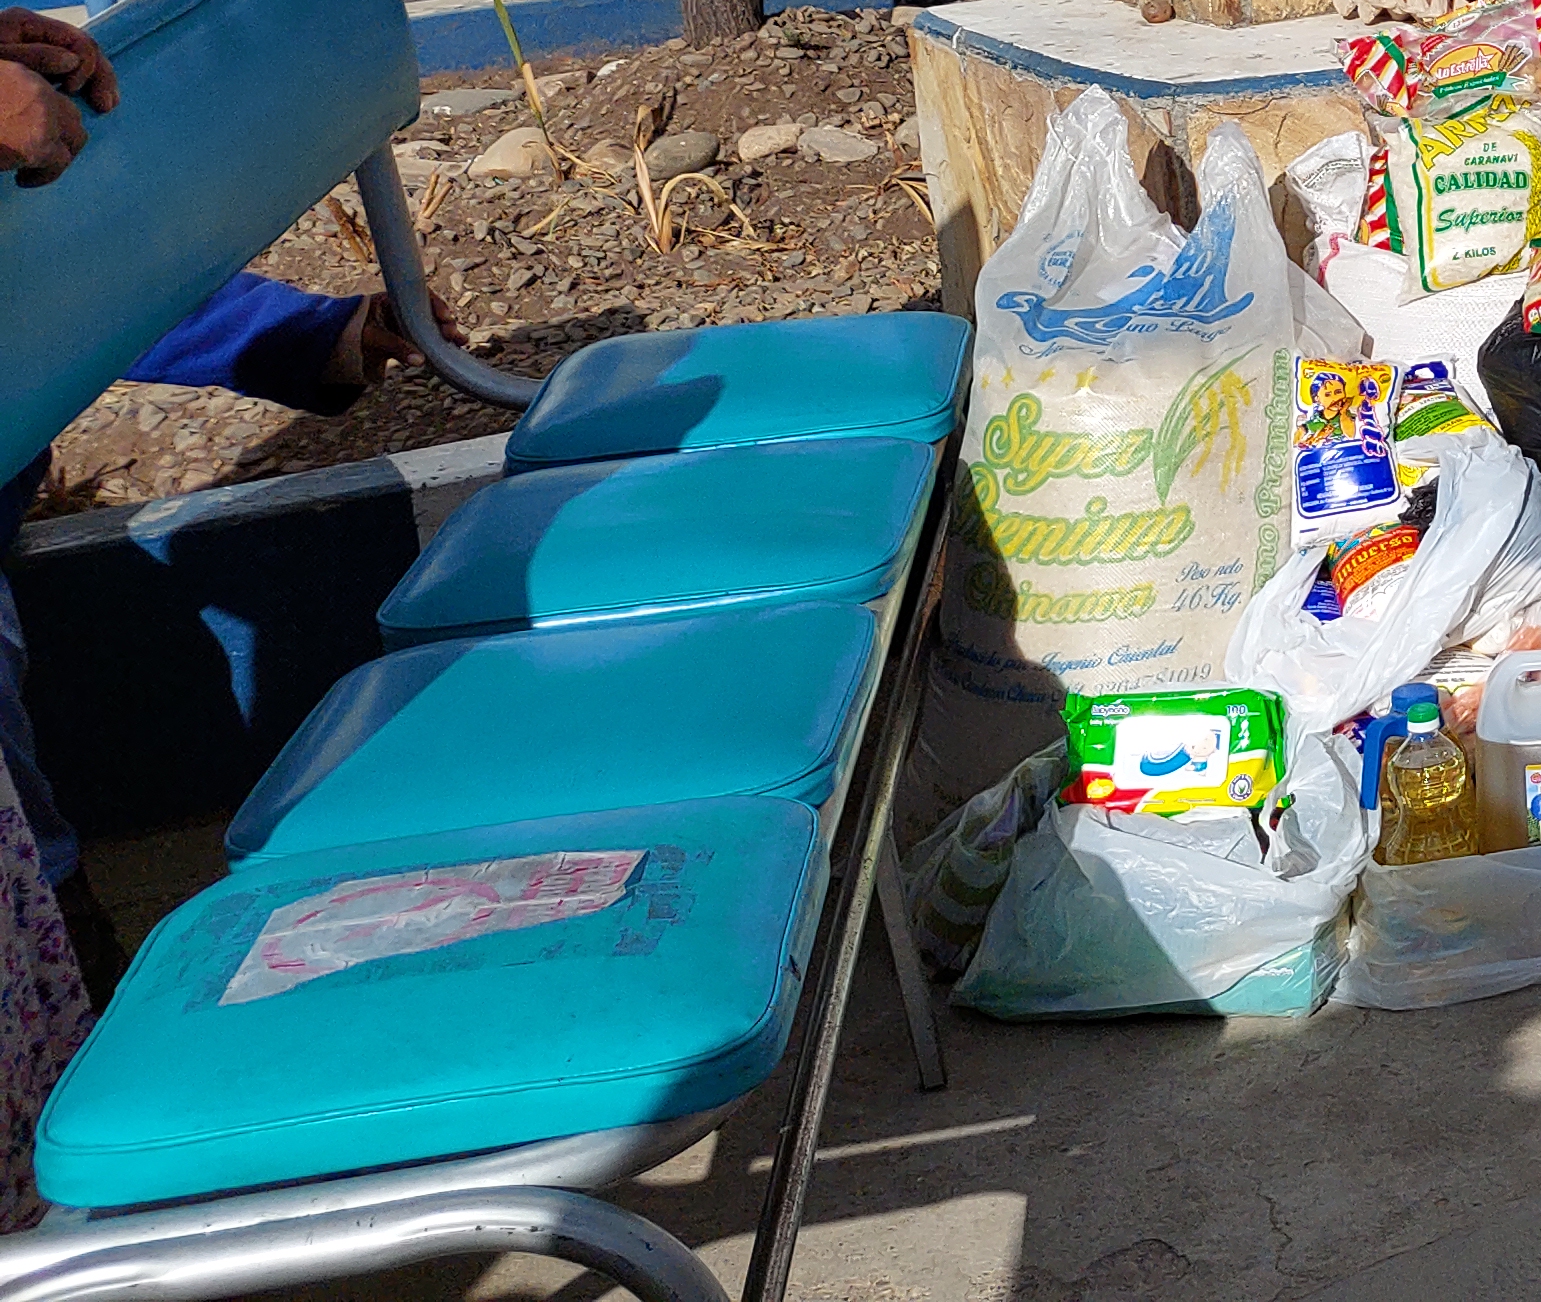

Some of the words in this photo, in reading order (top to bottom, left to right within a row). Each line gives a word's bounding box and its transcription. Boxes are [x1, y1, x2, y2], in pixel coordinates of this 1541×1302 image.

[1483, 142, 1498, 152] DE
[1463, 153, 1518, 166] CARANAVI
[1434, 170, 1530, 194] CALIDAD
[1435, 208, 1525, 233] Superior
[1463, 247, 1497, 259] KILOS
[982, 393, 1156, 496] Super
[1174, 564, 1210, 584] Peso
[1213, 559, 1244, 575] neto
[1171, 589, 1204, 613] 46
[1107, 637, 1182, 666] Oriental
